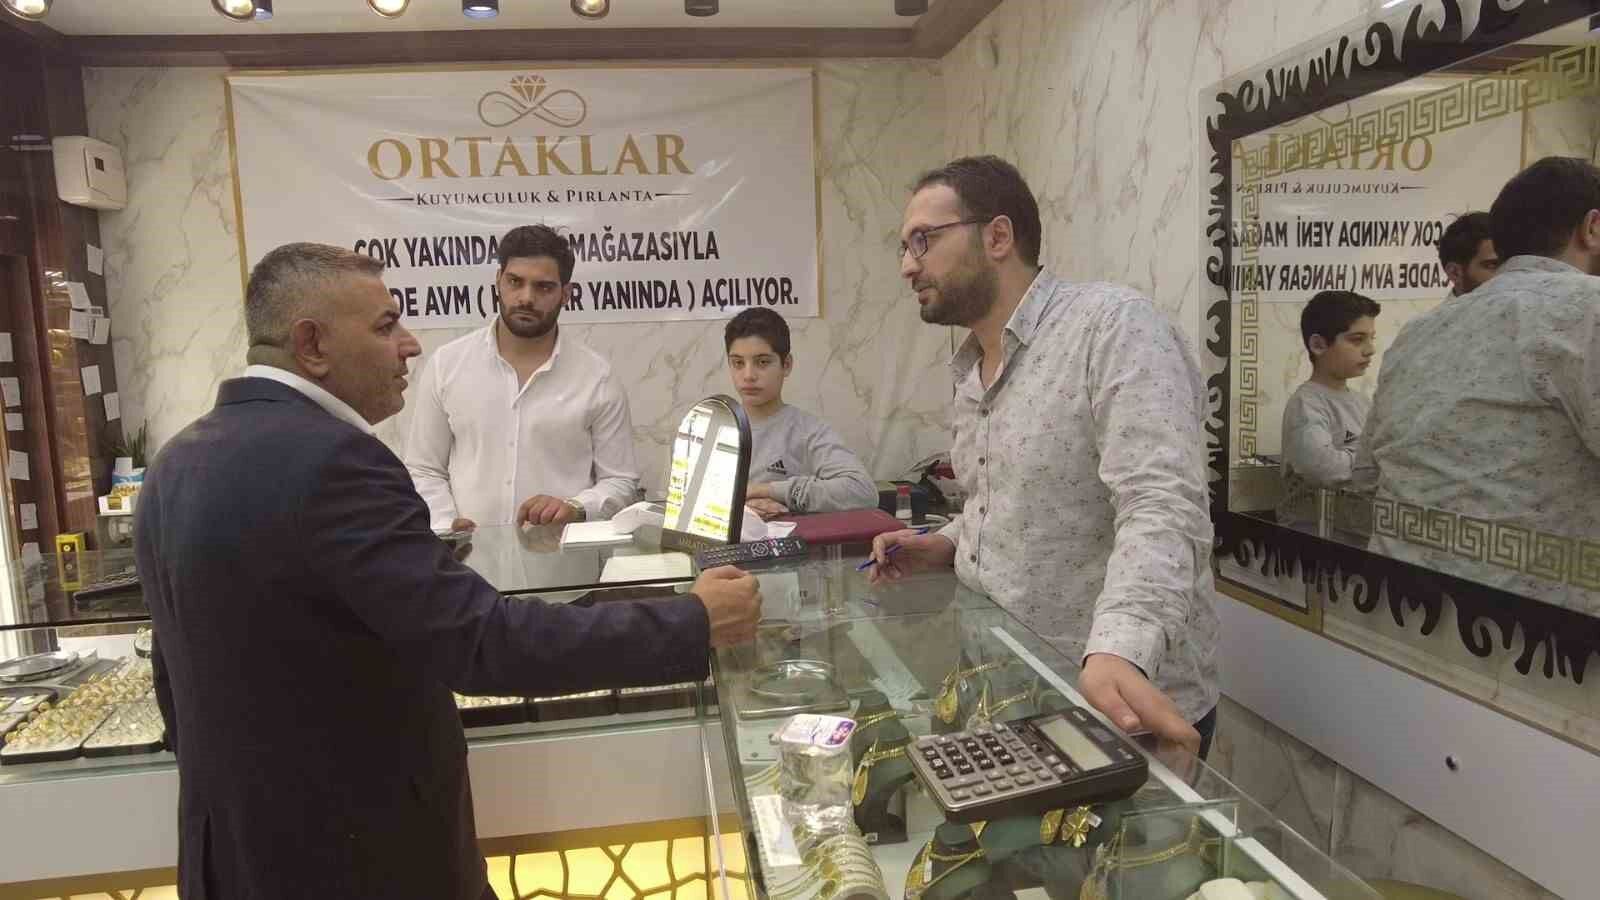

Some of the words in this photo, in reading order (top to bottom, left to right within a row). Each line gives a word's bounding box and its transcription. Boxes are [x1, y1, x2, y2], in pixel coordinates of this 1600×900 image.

[367, 133, 694, 181] ORTAKLAR
[416, 191, 541, 206] KUYUMCULUK
[547, 190, 560, 203] &
[567, 189, 653, 203] PIRLANTA
[404, 235, 500, 267] YAKINDA
[568, 226, 720, 262] MAĞAZASIYLA
[425, 285, 471, 316] AVM
[477, 285, 487, 318] (
[588, 279, 682, 311] YANINDA
[687, 279, 696, 312] )
[701, 277, 799, 312] AÇILIYOR.
